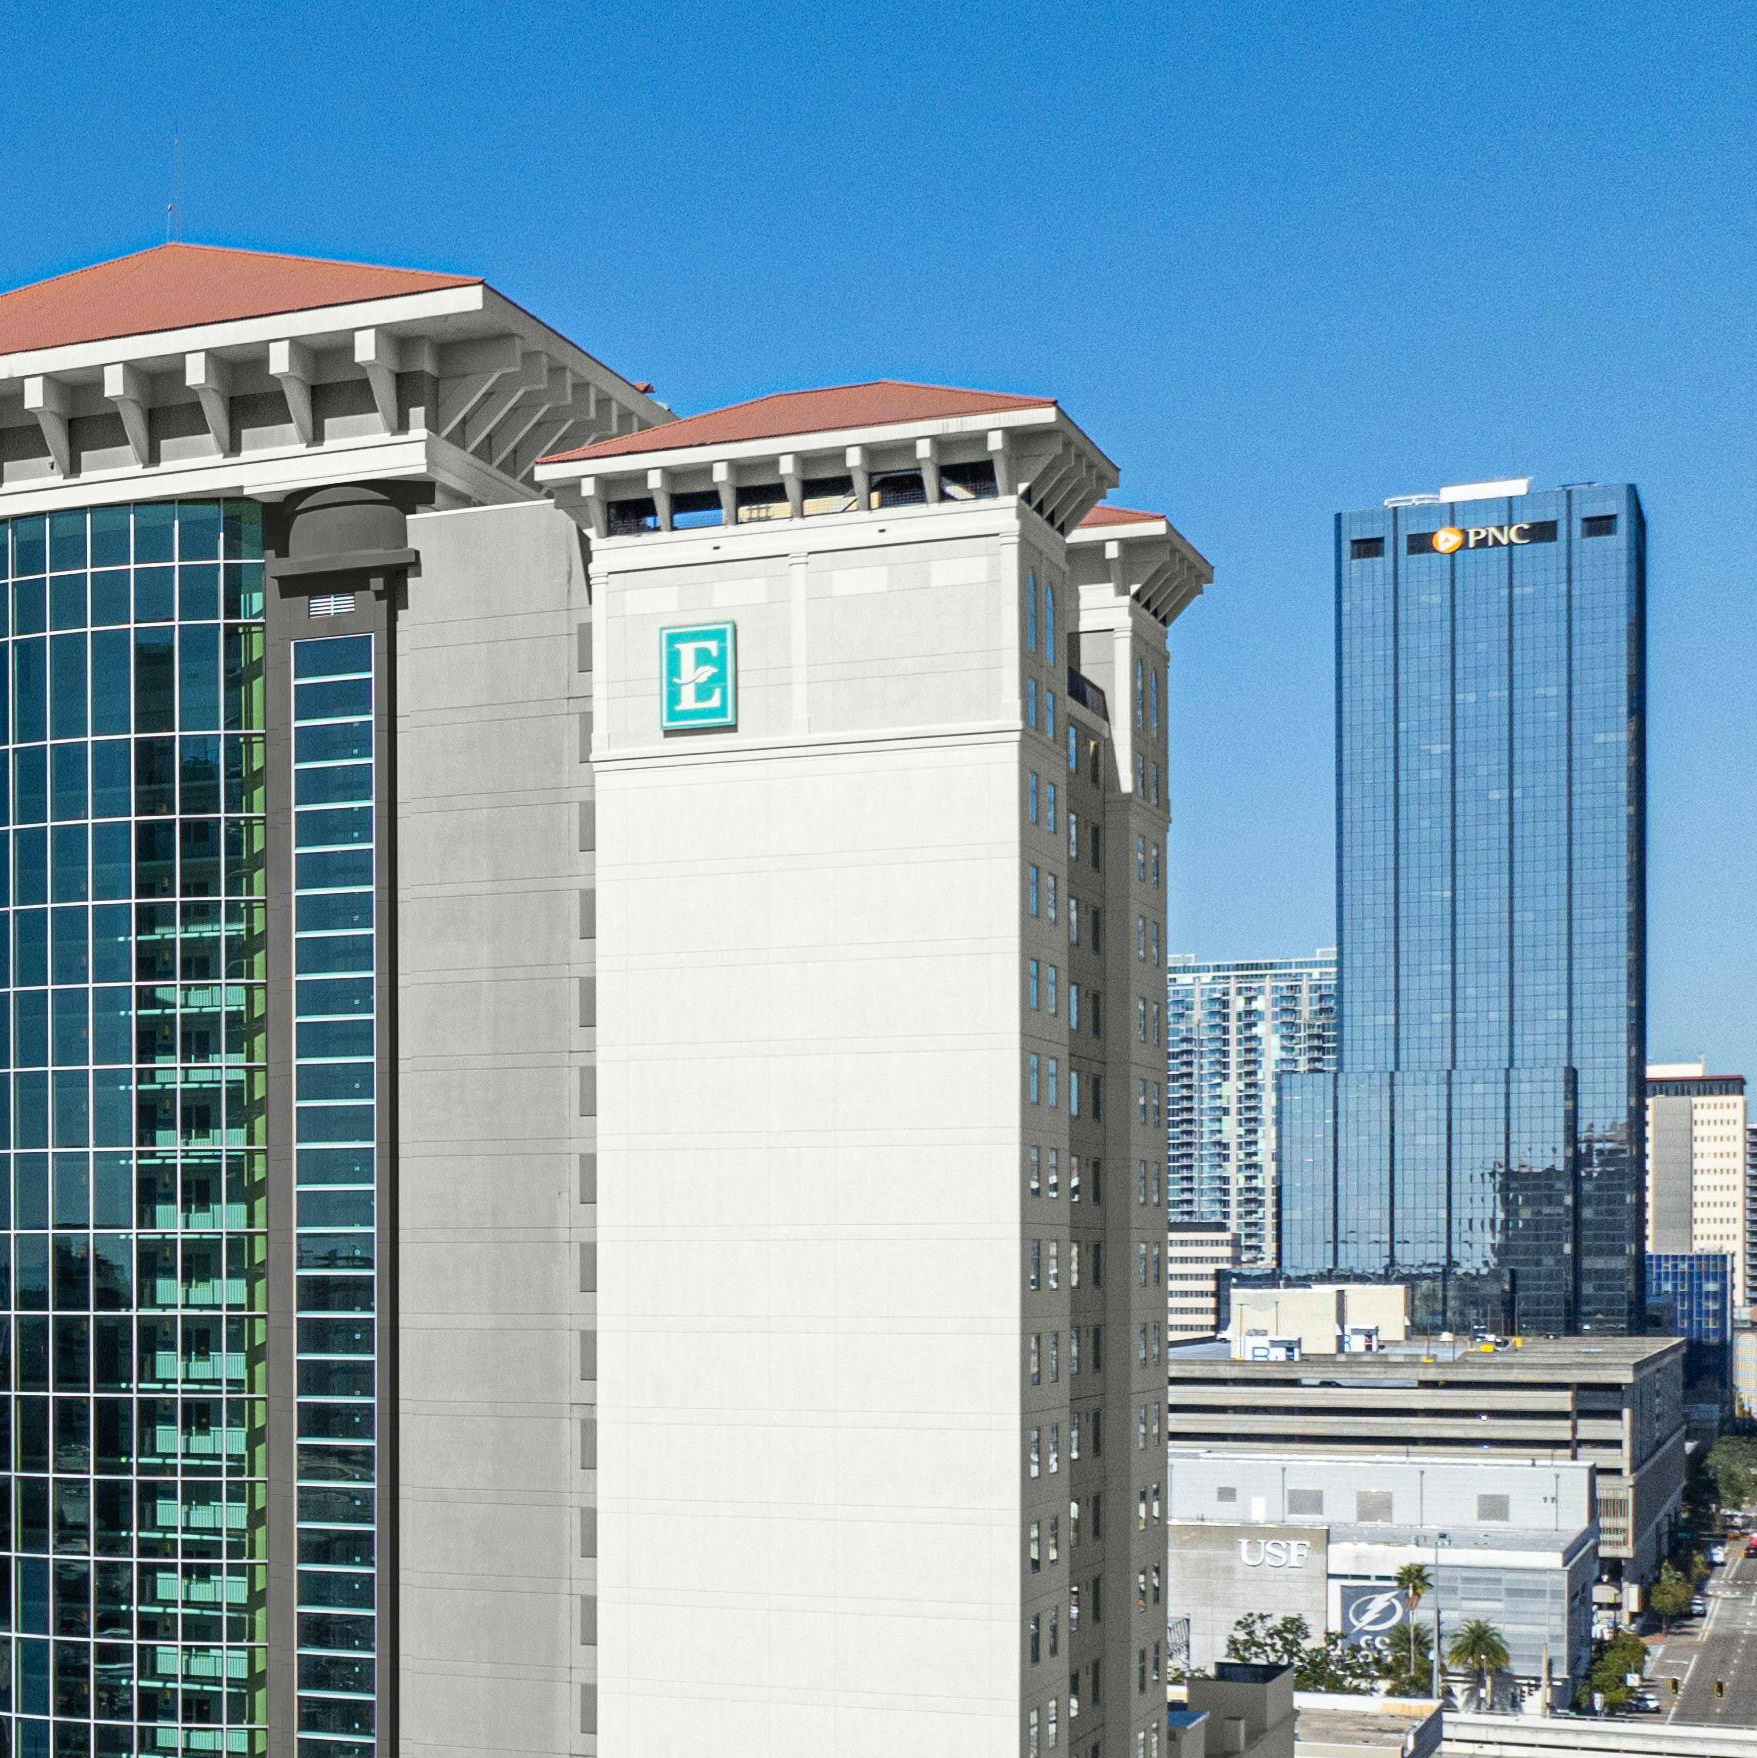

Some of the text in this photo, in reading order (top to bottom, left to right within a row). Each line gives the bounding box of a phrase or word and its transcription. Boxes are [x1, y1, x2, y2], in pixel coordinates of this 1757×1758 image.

[1466, 523, 1531, 548] PNC
[672, 639, 721, 711] E
[1238, 1538, 1311, 1568] USF
